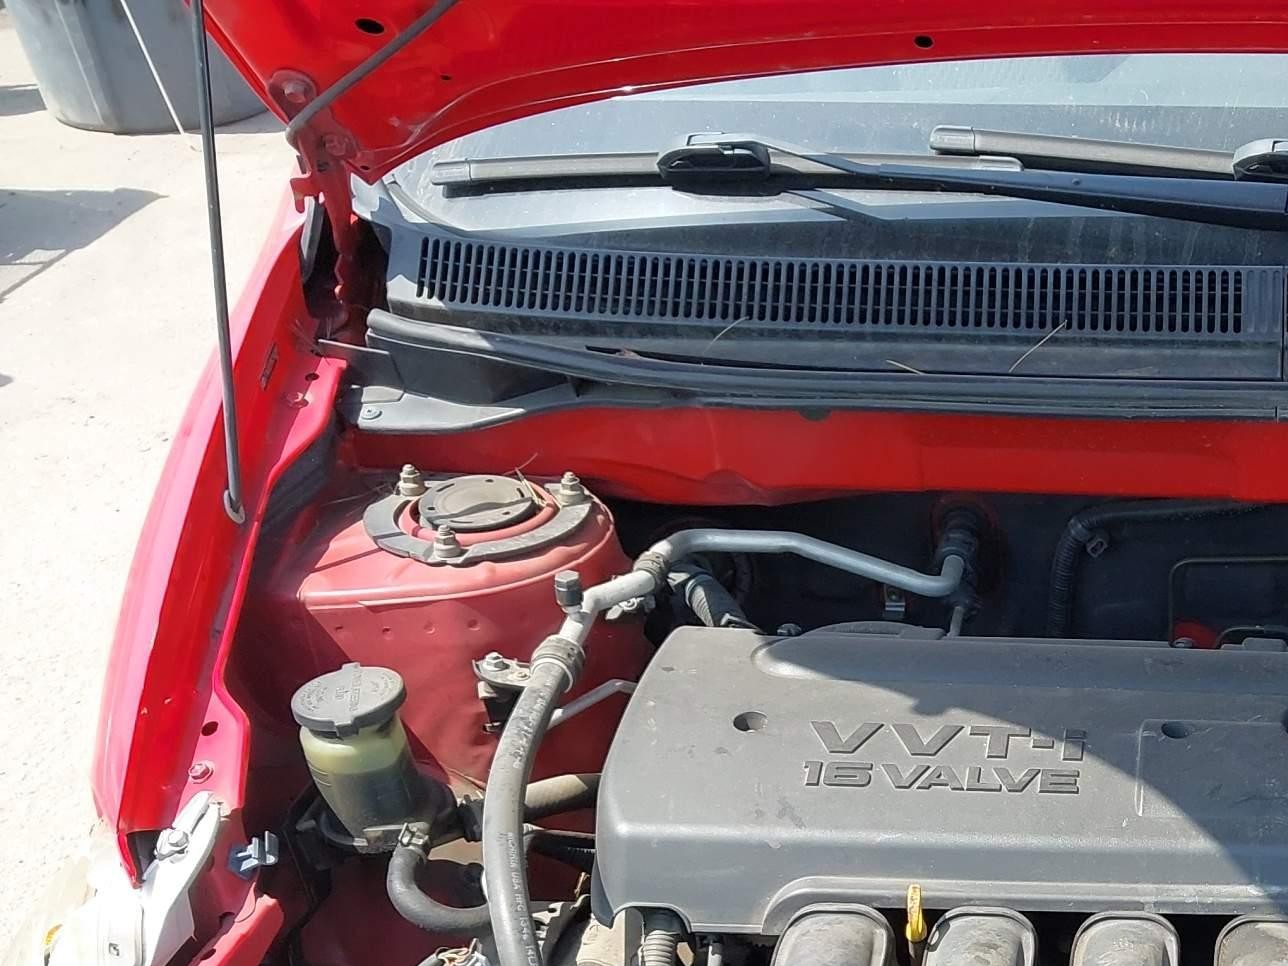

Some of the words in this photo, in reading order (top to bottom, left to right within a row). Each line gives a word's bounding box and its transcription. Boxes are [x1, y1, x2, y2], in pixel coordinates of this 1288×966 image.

[810, 721, 1087, 761] VVT-i
[804, 761, 873, 788] 16
[882, 763, 1081, 794] VALVE
